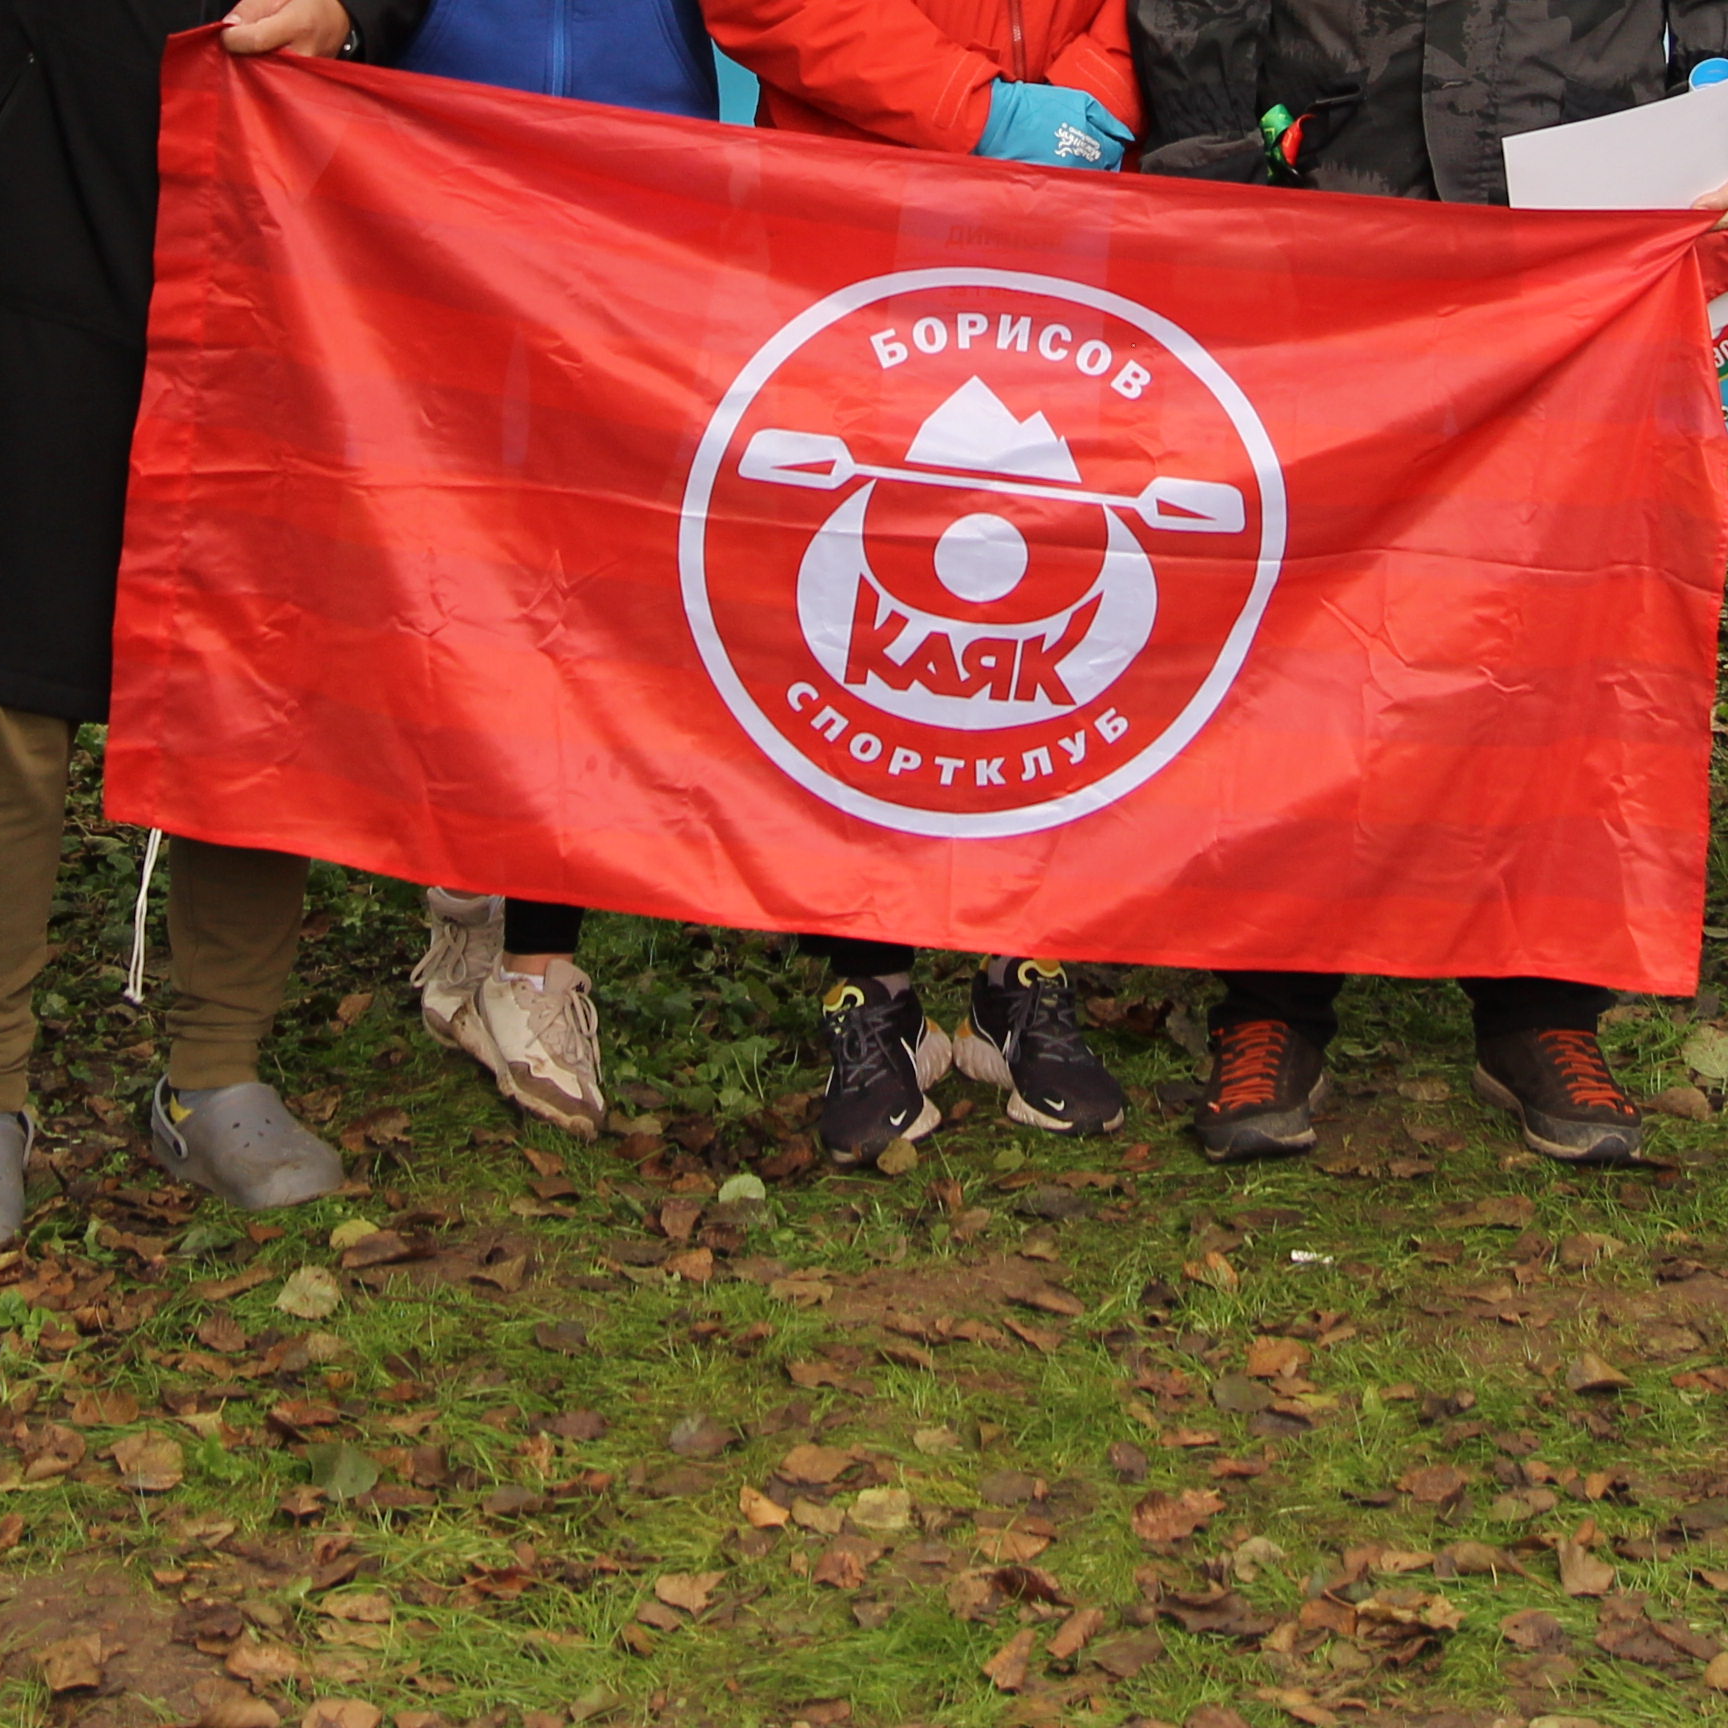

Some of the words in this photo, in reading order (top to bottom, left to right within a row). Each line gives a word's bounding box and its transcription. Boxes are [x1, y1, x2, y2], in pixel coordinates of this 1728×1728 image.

[870, 311, 1151, 400] БОРИСОВ
[844, 572, 1105, 707] КАЯК
[784, 680, 1130, 786] СПОРТКЛУБ
